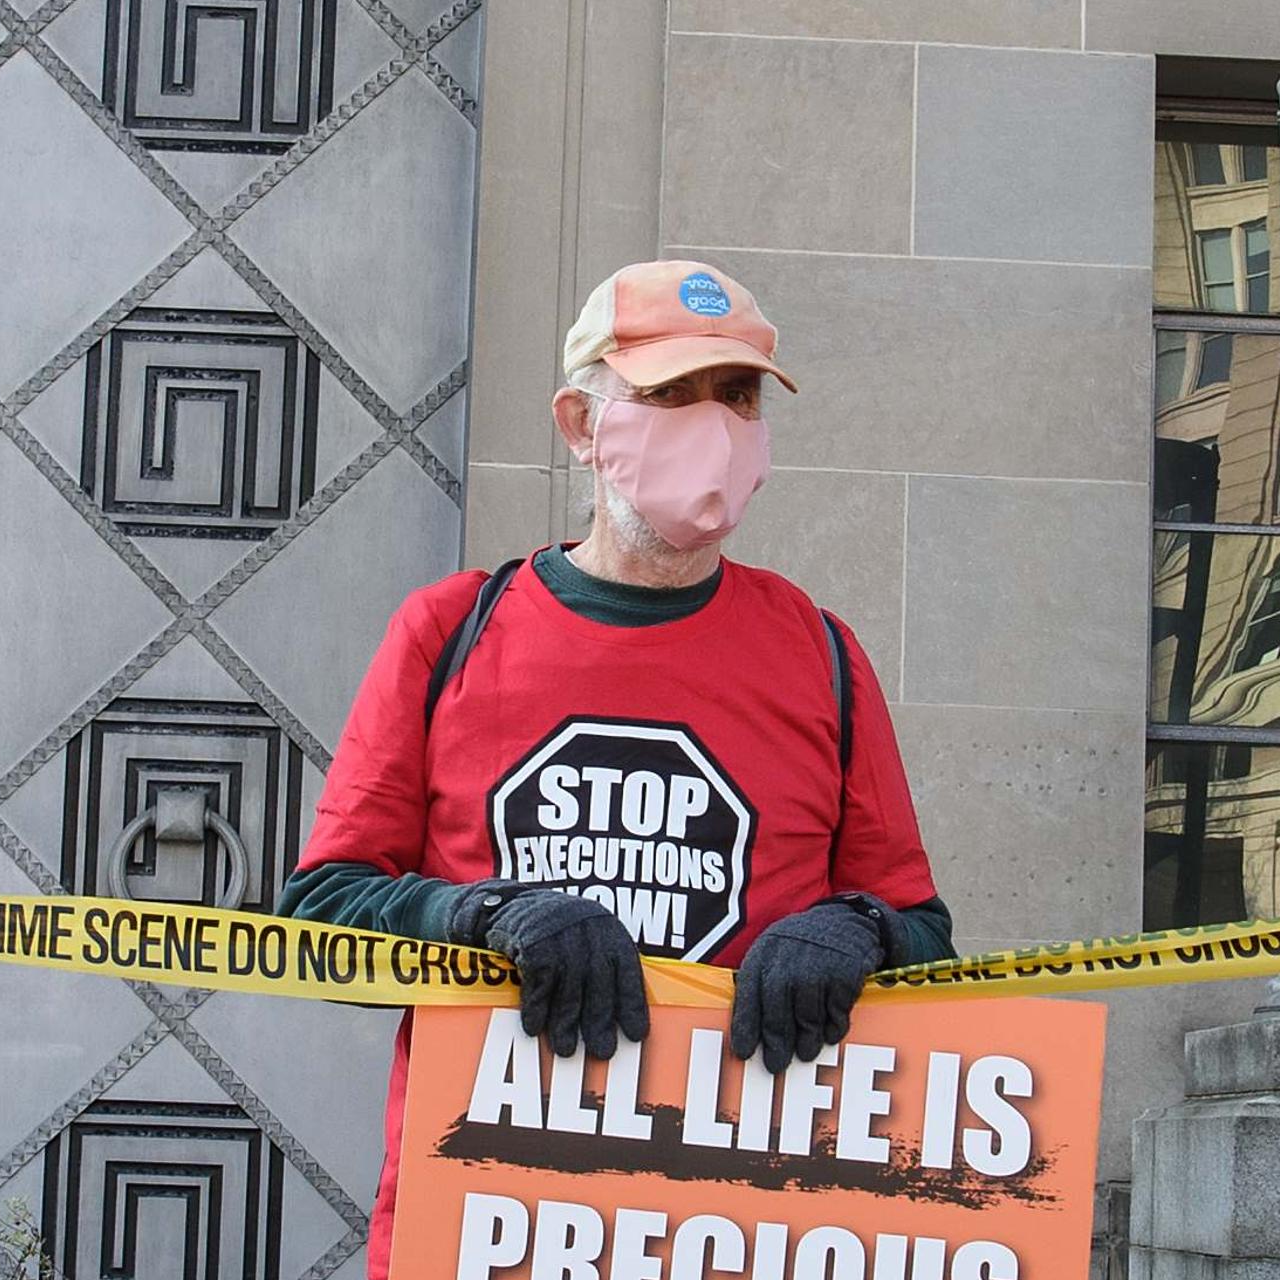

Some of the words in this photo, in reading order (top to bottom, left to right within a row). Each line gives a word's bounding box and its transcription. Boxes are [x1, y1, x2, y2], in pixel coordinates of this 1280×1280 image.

[537, 764, 710, 839] STOP
[514, 835, 725, 893] EXECUTIONS
[82, 908, 219, 973] SCENE
[228, 922, 287, 979] DO
[298, 930, 385, 985] NOT
[391, 940, 521, 986] CROS
[466, 1008, 652, 1141] ALL
[682, 1028, 896, 1163] LIFE
[921, 1051, 1034, 1177] IS
